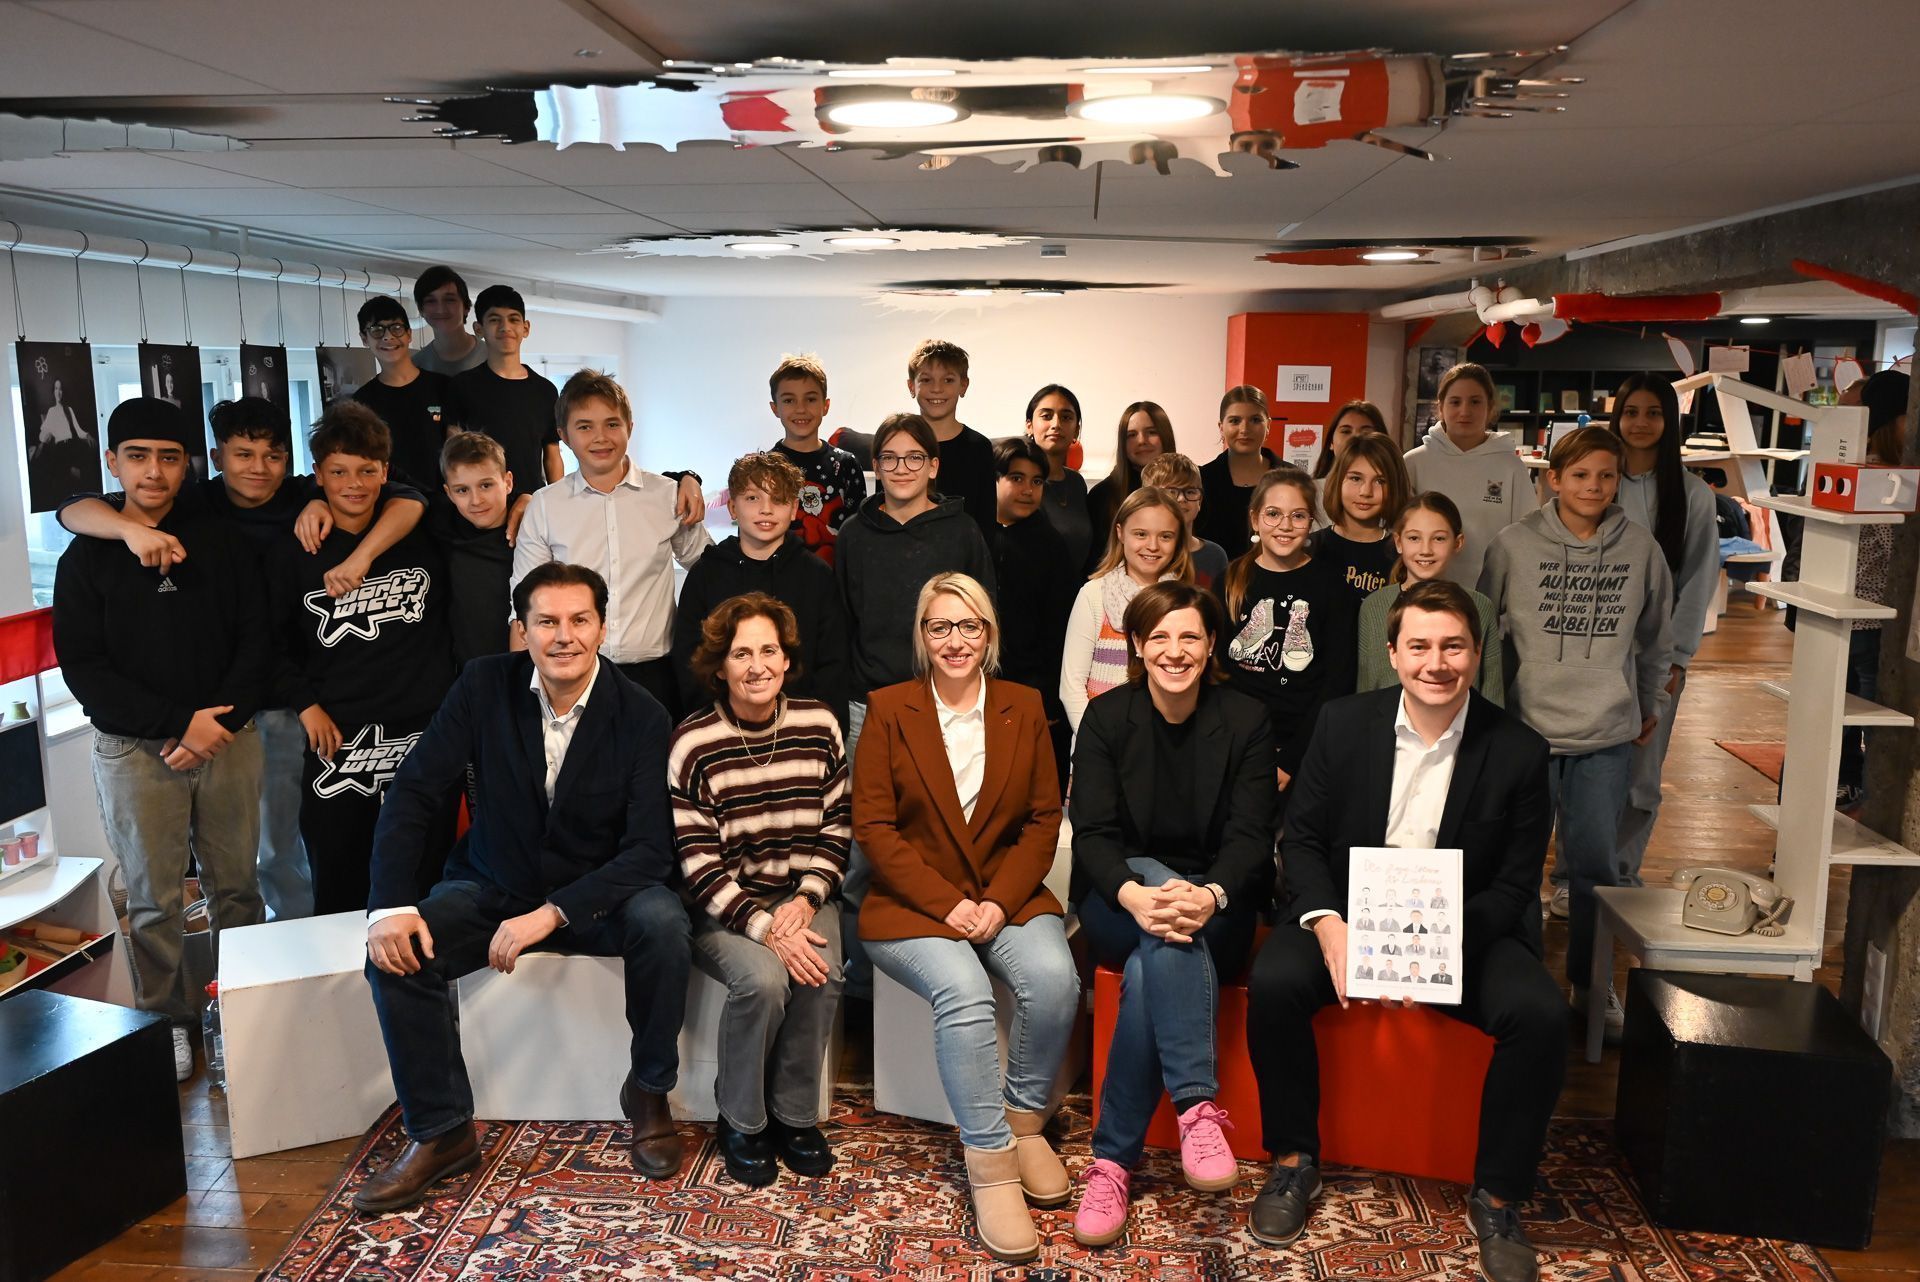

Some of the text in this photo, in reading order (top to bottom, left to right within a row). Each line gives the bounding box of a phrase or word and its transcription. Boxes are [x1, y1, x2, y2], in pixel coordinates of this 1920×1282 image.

[1539, 562, 1560, 571] WER
[1612, 563, 1630, 573] MIR
[1345, 565, 1386, 593] Potter
[157, 585, 178, 593] adidas
[1570, 593, 1594, 603] EBEN
[1596, 594, 1622, 603] NOCH
[1538, 602, 1554, 612] EIN
[1589, 605, 1603, 615] N
[1604, 605, 1626, 615] SICH
[1543, 615, 1619, 632] ARBEITEN
